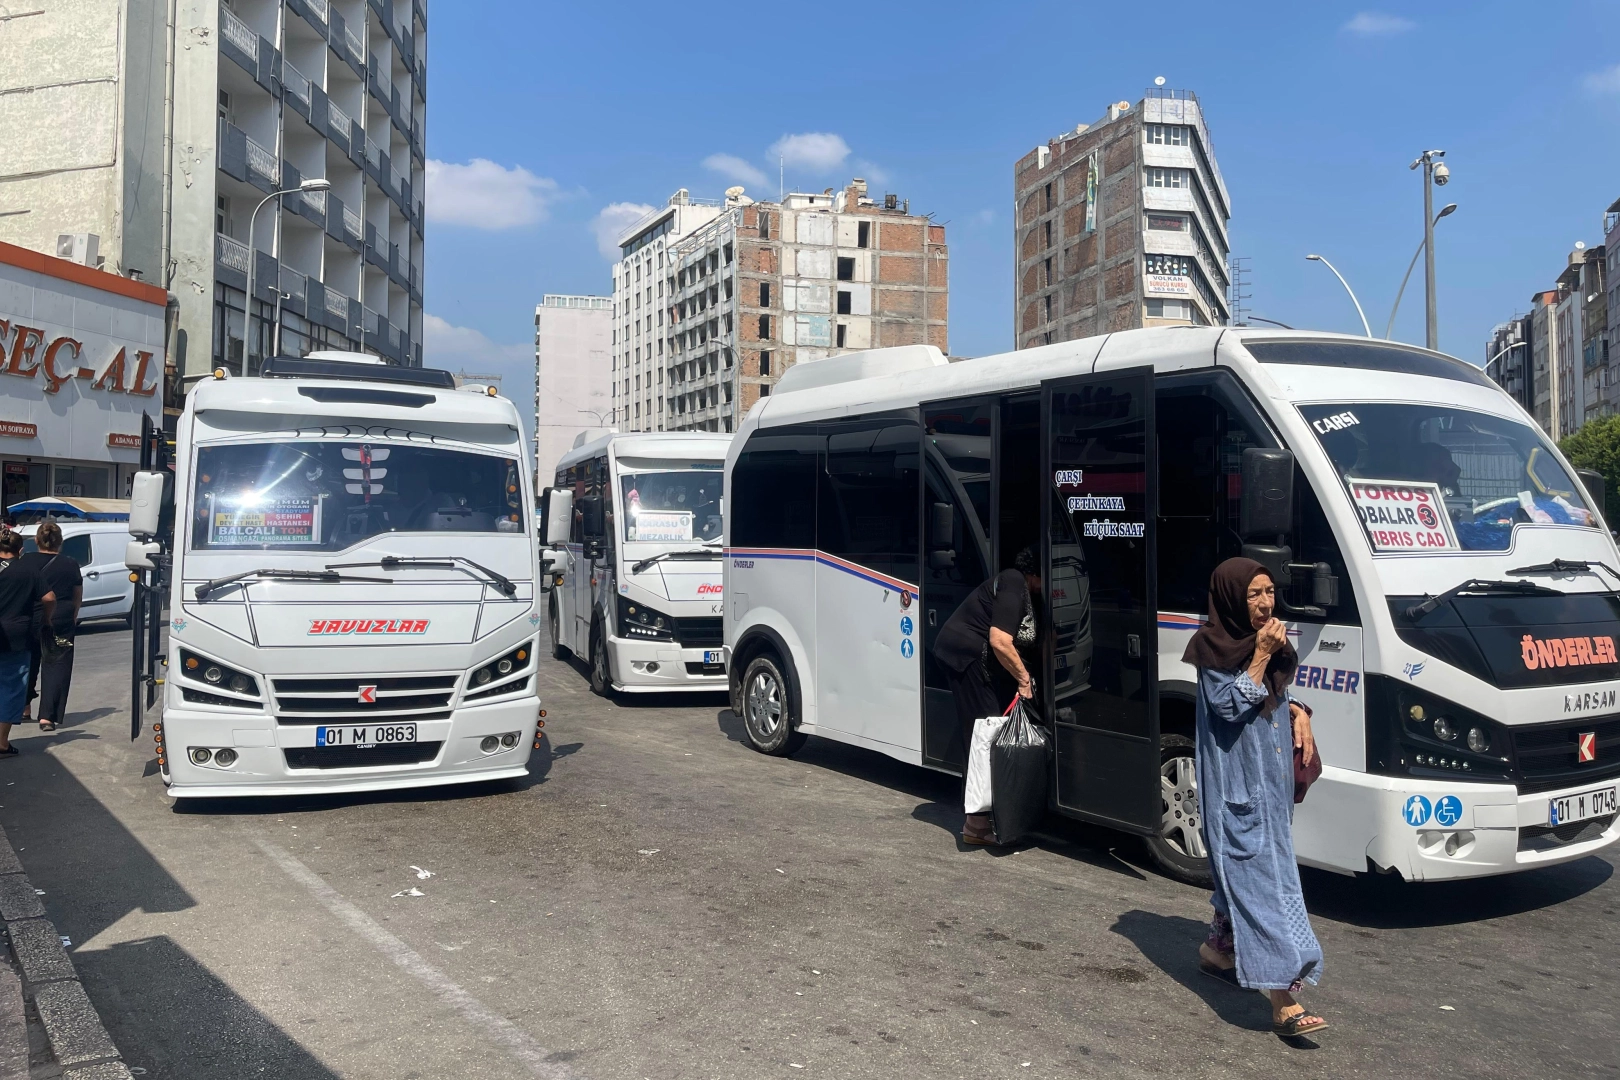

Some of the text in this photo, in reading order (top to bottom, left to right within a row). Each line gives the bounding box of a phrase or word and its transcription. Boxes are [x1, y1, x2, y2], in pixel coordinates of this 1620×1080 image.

[1170, 281, 1188, 289] KURSU
[8, 425, 35, 435] SOFRAYA
[115, 436, 134, 446] ADANA
[1055, 470, 1083, 487] ÇARŞI
[1353, 484, 1429, 502] TOROS
[1067, 493, 1125, 514] ÇETİNKAYA
[1420, 507, 1436, 527] 3
[218, 526, 276, 535] BALCALI
[639, 533, 684, 541] MEZARLIK
[1084, 519, 1145, 540] KÜÇÜK SAAT
[1371, 531, 1446, 547] IBRIS CAD
[307, 619, 431, 636] YAVUZLAR
[709, 652, 720, 662] 01
[1520, 634, 1618, 670] ÖNDERLER
[1294, 664, 1360, 694] ERLER
[1563, 690, 1616, 713] KARSAN
[326, 729, 342, 744] 01
[353, 728, 366, 744] M
[375, 726, 414, 742] 0863
[1558, 799, 1570, 821] 01
[1578, 796, 1586, 818] M
[1592, 790, 1616, 814] 0748
